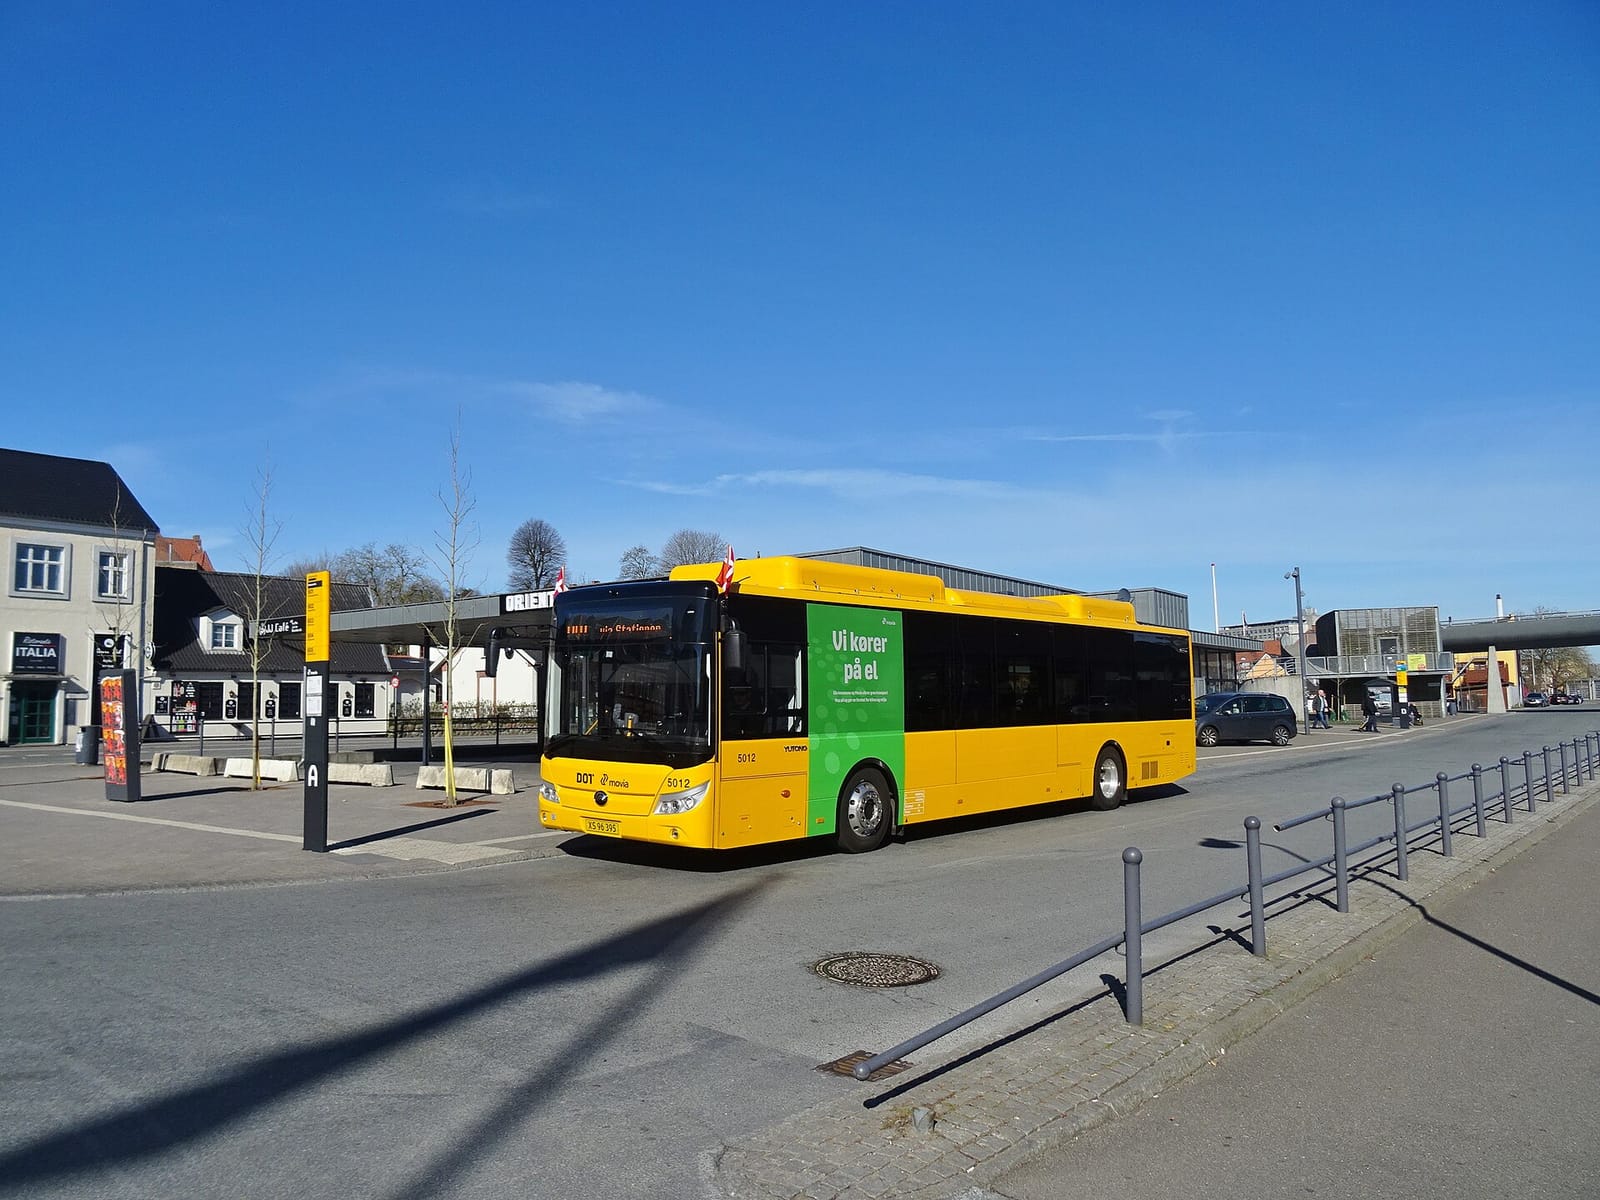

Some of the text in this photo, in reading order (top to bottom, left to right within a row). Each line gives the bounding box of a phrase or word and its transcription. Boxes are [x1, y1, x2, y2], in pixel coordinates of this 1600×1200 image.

[832, 629, 888, 653] Vi kører
[15, 646, 57, 658] ITALIA
[844, 657, 879, 684] på el
[737, 753, 756, 763] 5012
[307, 764, 319, 787] A
[576, 772, 593, 784] DOT
[608, 779, 629, 789] movia
[667, 777, 690, 789] 5012
[596, 822, 605, 831] 96
[605, 823, 617, 833] 395
